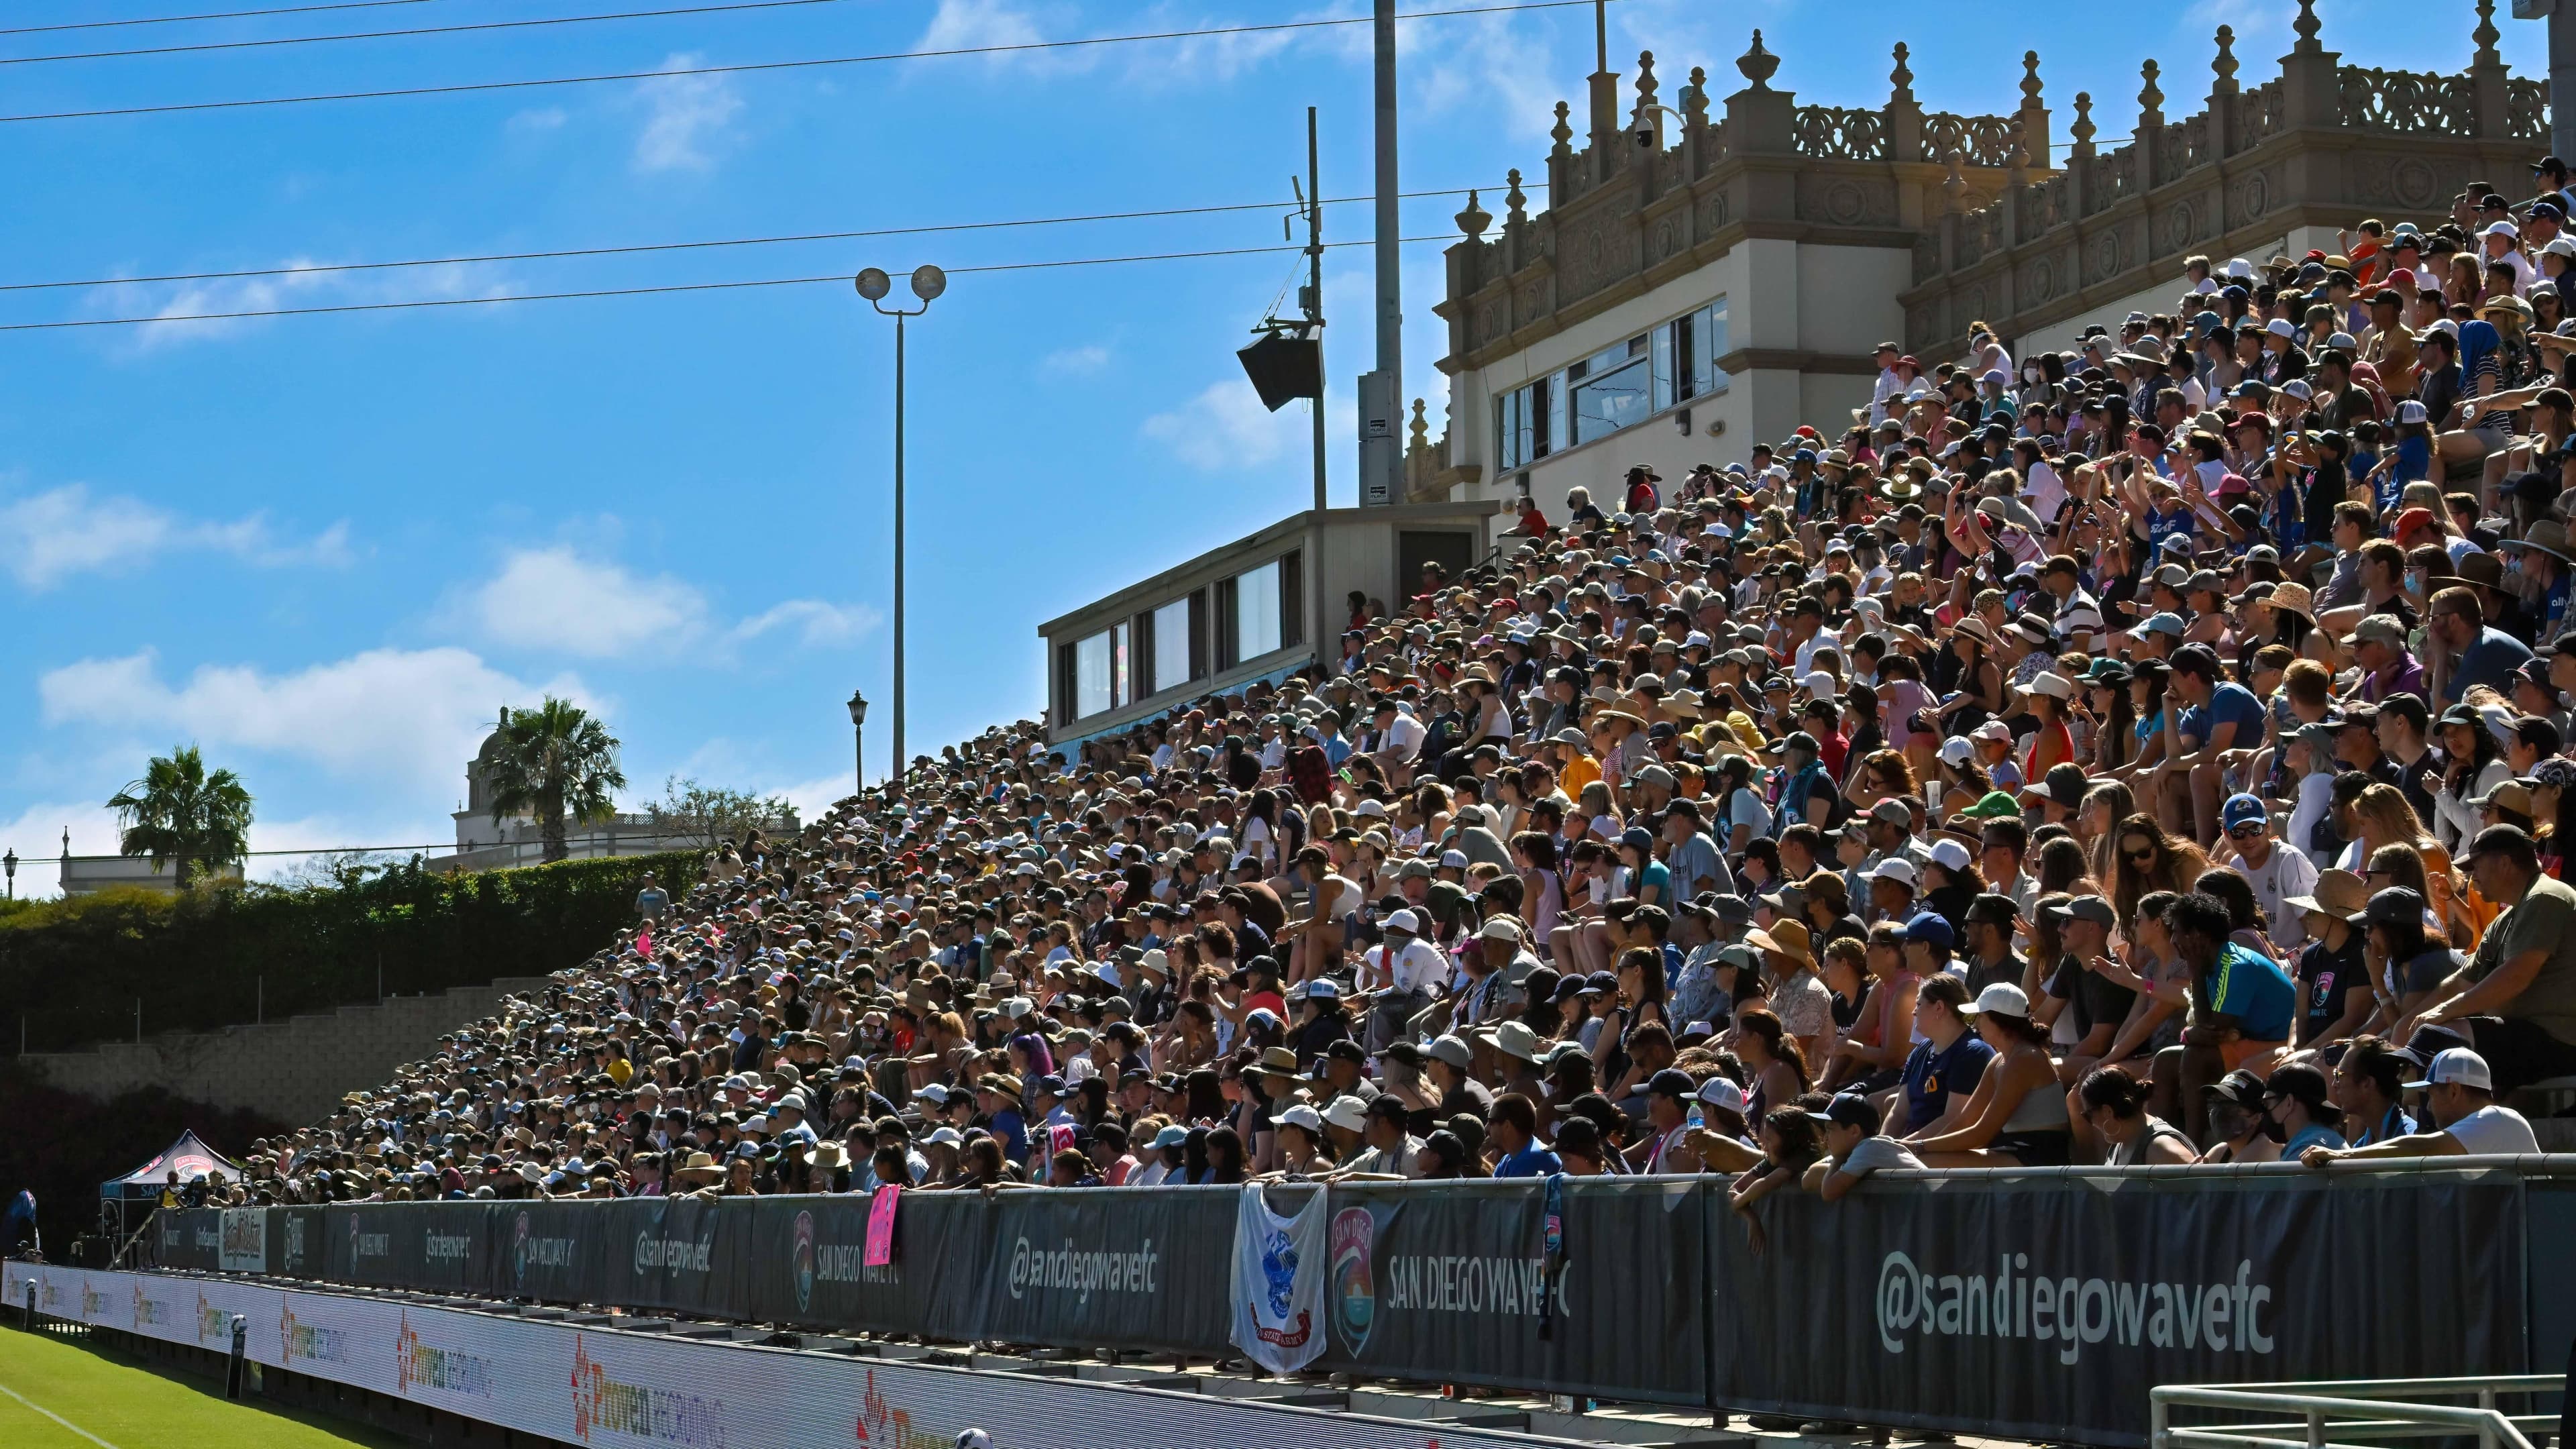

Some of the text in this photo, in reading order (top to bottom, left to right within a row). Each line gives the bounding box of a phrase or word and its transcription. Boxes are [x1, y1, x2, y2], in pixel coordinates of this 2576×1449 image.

[817, 1244, 833, 1281] SAN
[835, 1244, 860, 1283] DIEGO
[1334, 1218, 1371, 1251] SAN DIEGO
[1388, 1255, 1421, 1309] SAN
[1427, 1256, 1483, 1312] DIEGO
[1486, 1257, 1544, 1316] WAVE
[1878, 1250, 2275, 1366] @sandiegowavefc
[409, 1331, 445, 1389] Proven
[1281, 1333, 1303, 1346] ARMY
[592, 1363, 651, 1436] Proven
